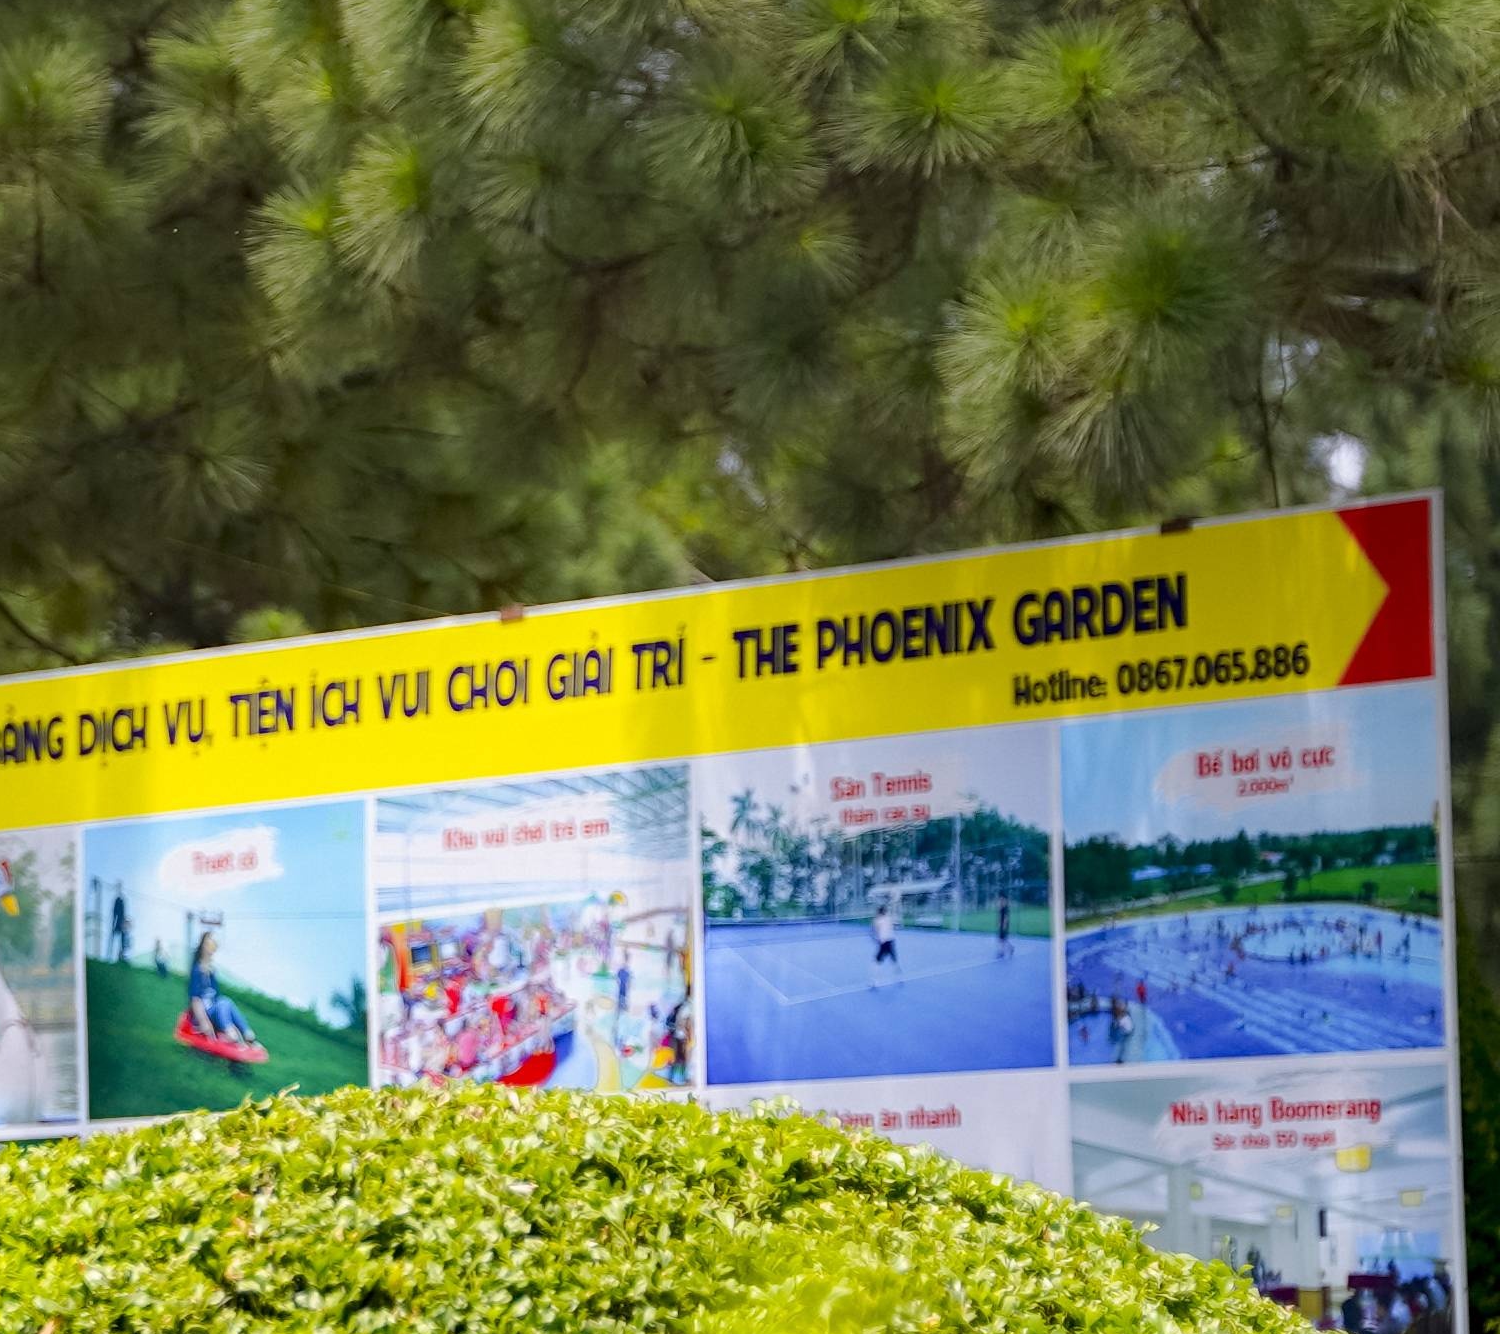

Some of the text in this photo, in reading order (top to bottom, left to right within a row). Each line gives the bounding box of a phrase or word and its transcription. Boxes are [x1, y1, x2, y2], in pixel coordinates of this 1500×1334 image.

[78, 705, 148, 767] DỊCH
[229, 676, 295, 750] TIỆN
[378, 670, 430, 720] VUI
[547, 629, 614, 701] GIẢI
[732, 623, 799, 679] THE
[816, 597, 995, 670] PHOENIX
[1013, 572, 1187, 647] GARDEN
[1012, 641, 1311, 706] Hotline: 0867.065.886
[871, 770, 932, 797] Tennis
[1170, 1096, 1382, 1128] Nhà hàng Boomerang
